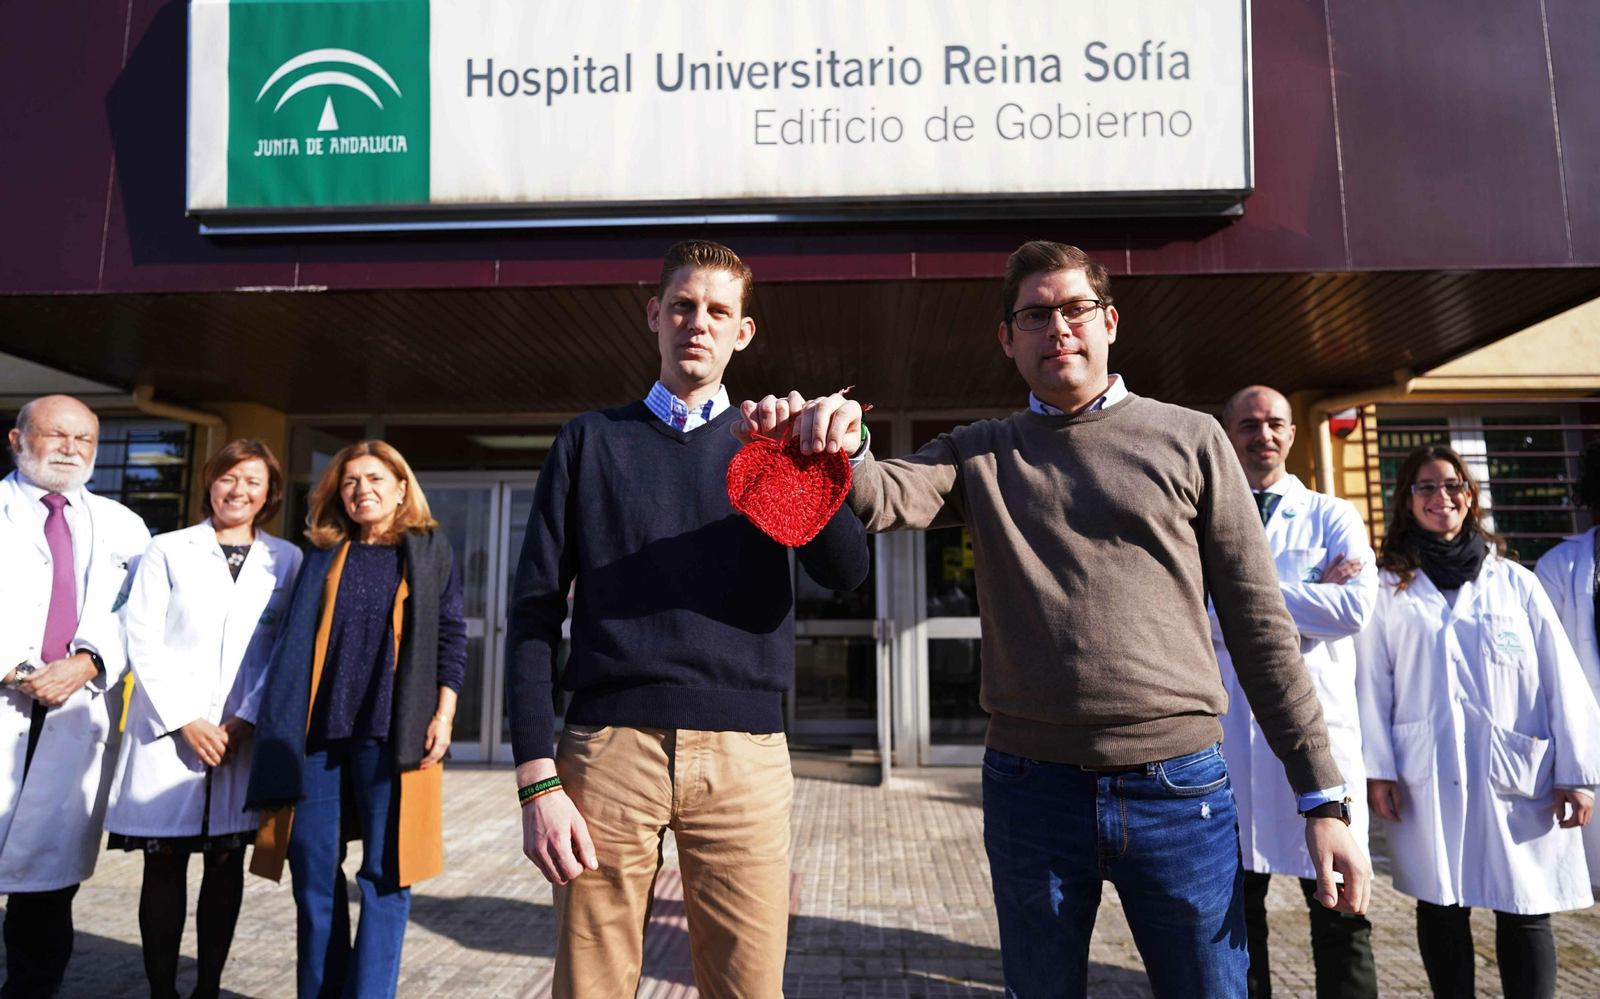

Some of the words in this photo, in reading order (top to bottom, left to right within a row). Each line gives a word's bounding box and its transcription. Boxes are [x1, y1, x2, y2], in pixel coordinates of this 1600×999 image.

[466, 53, 632, 106] Hospital
[656, 49, 921, 93] Universitario
[944, 44, 1062, 85] Reina
[1083, 40, 1192, 83] Sofía
[253, 138, 300, 157] JUNTA
[305, 137, 324, 156] DE
[329, 135, 408, 155] ANDALUCIA
[754, 107, 904, 146] Edificio
[924, 104, 976, 143] de
[995, 102, 1193, 141] Gobierno
